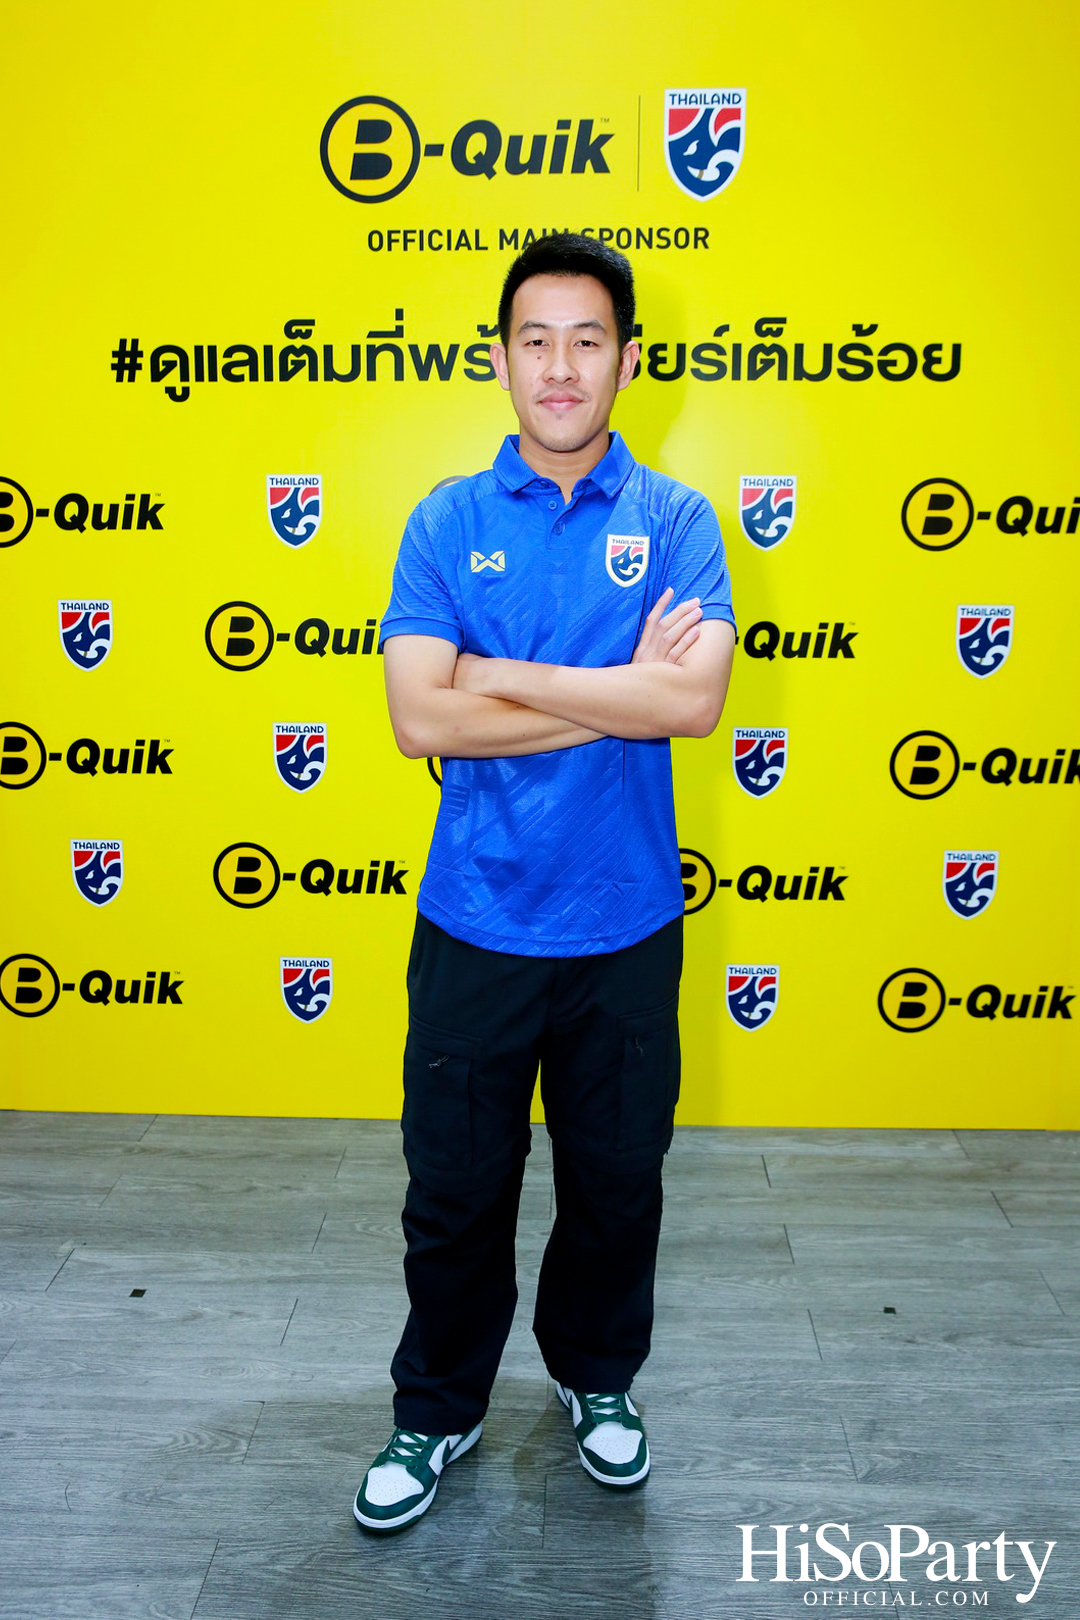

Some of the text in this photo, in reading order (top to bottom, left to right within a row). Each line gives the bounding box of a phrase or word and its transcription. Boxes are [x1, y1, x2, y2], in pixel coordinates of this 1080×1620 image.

[669, 93, 742, 105] THAILAND
[319, 95, 614, 203] B-Quik
[368, 229, 488, 251] OFFICIAL
[499, 228, 568, 251] MA
[269, 477, 319, 486] THAILAND
[742, 478, 794, 487] THAILAND
[901, 477, 1080, 551] B-Qui
[612, 538, 645, 546] THAILAND
[61, 602, 109, 610] THAILAND
[960, 608, 1011, 616] THAILAND
[205, 601, 384, 672] B-Qui
[275, 725, 324, 733] THAILAND
[735, 730, 785, 738] THAILAND
[0, 721, 174, 790] B-Quik
[73, 842, 120, 850] THAILAND
[947, 853, 996, 861] THAILAND
[213, 842, 409, 909] B-Quik
[282, 959, 330, 968] THAILAND
[729, 967, 777, 975] THAILAND
[0, 953, 184, 1018] B-Quik
[878, 967, 1076, 1033] B-Quik
